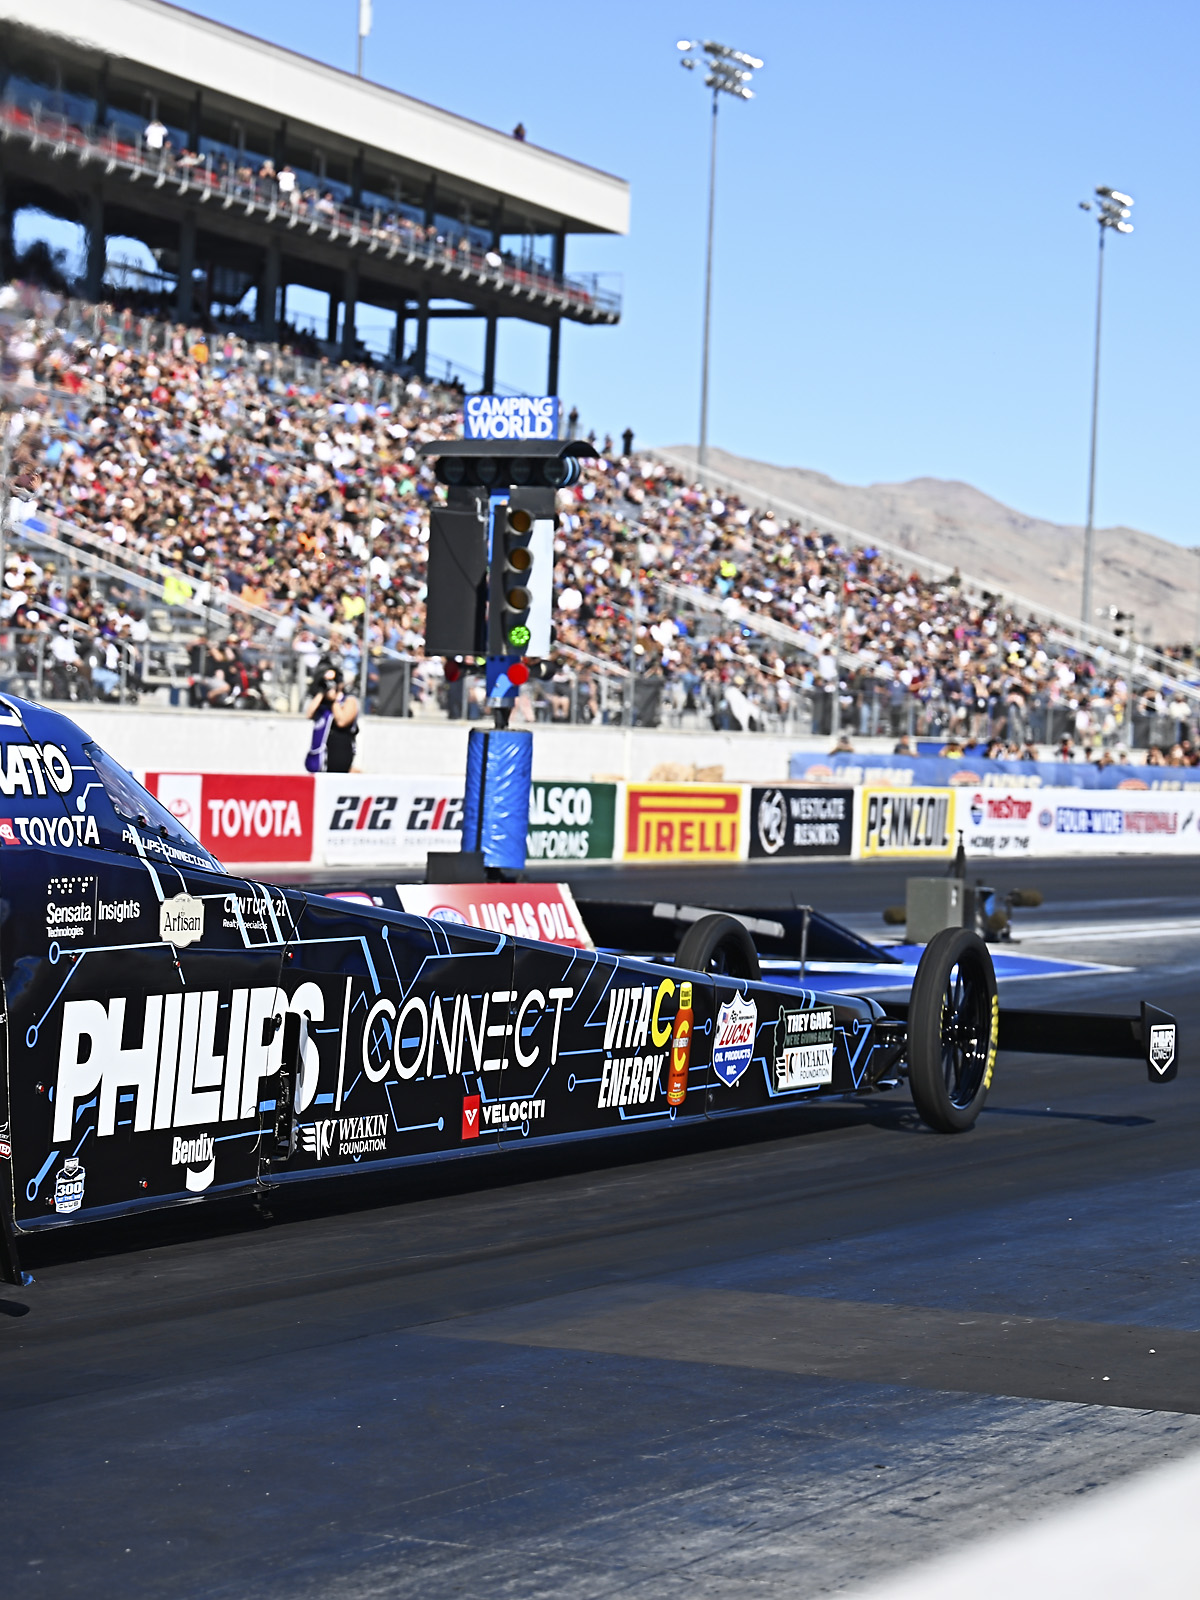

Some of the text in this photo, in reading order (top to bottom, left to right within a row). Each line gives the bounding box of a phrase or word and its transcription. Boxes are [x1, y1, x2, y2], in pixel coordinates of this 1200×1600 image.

[467, 397, 553, 416] CAMPING
[468, 415, 553, 439] WORLD
[207, 799, 302, 838] TOYOTA
[329, 796, 398, 830] 212
[790, 797, 845, 820] WESTGATE
[1056, 808, 1121, 832] FOUR-WIDE
[14, 815, 100, 848] TOYOTA
[627, 790, 740, 853] PIRELLI
[865, 796, 950, 849] PENNZOIL
[526, 830, 589, 858] NIFORMS
[793, 823, 840, 846] RESORTS
[46, 900, 141, 924] Sensata Insights
[163, 910, 201, 932] Artisan
[469, 902, 538, 939] LUCAS
[538, 903, 576, 940] OIL
[46, 925, 84, 938] Technologies
[719, 1022, 754, 1046] LUCAS
[787, 1013, 809, 1033] THEY
[53, 981, 575, 1144] PHILLIPS CONNECT
[715, 1048, 751, 1063] OIL PRODUCTS
[800, 1048, 831, 1068] WYAKIN
[597, 1055, 665, 1109] ENERGY
[800, 1067, 830, 1079] FOUNDATION
[483, 1100, 546, 1125] VELOCITI
[338, 1113, 389, 1140] WYAKIN
[171, 1132, 215, 1166] Bendix
[57, 1181, 83, 1197] 300
